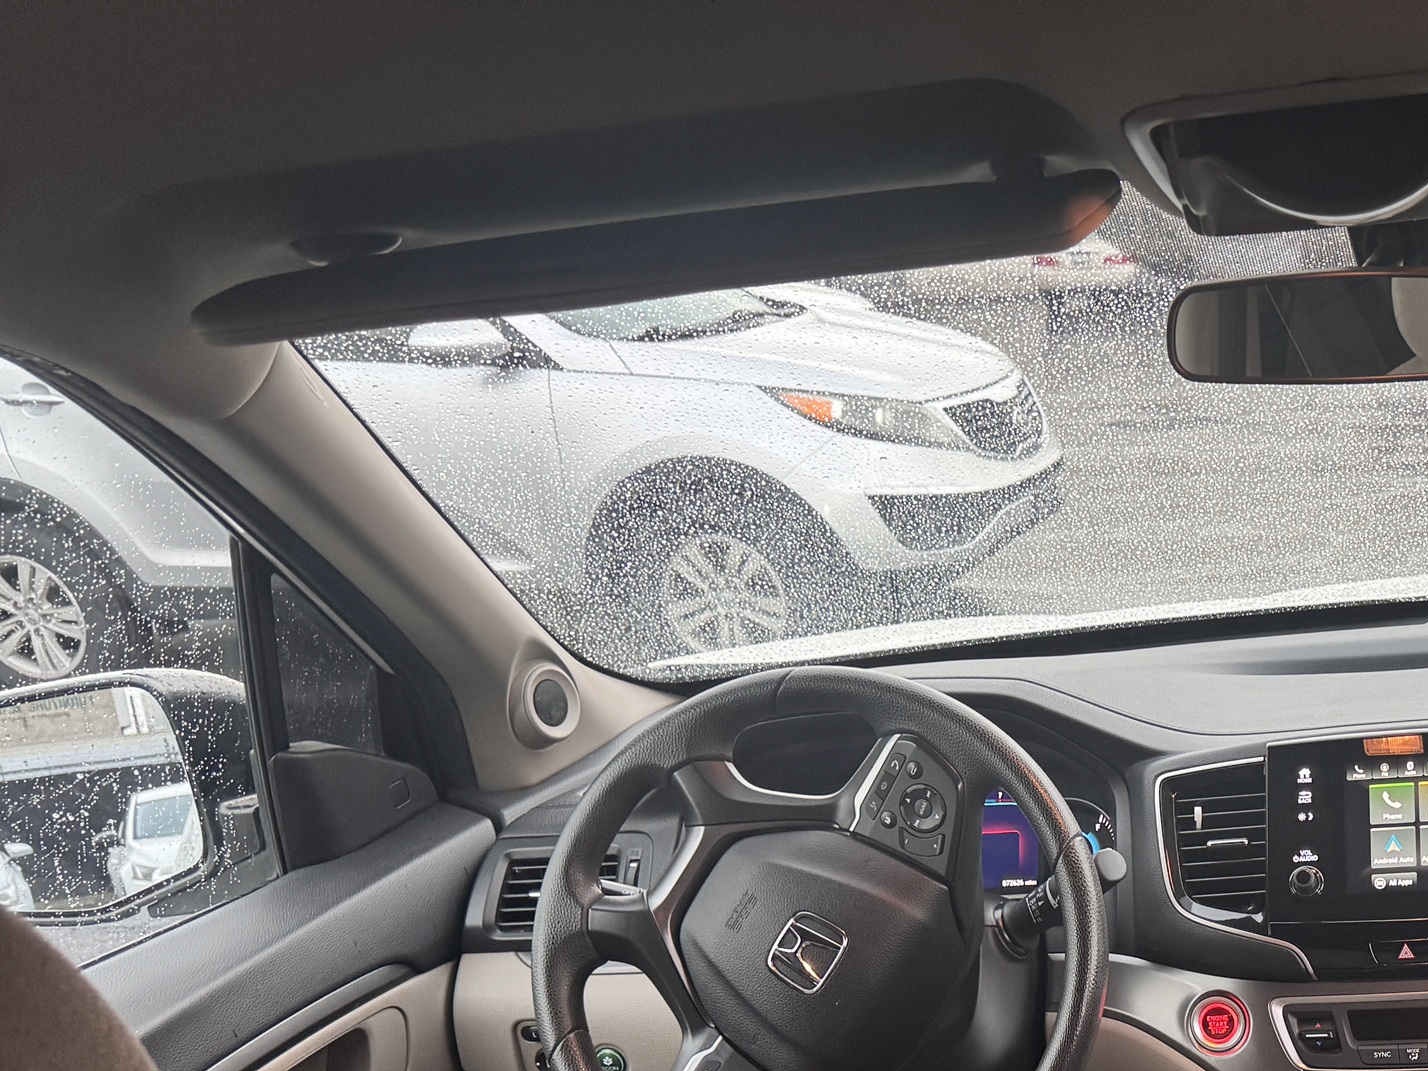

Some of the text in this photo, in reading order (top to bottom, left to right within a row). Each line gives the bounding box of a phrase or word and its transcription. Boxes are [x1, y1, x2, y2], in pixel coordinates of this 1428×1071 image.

[1373, 857, 1398, 865] Android
[1389, 878, 1413, 887] All Apps
[1373, 1050, 1392, 1058] SYNC
